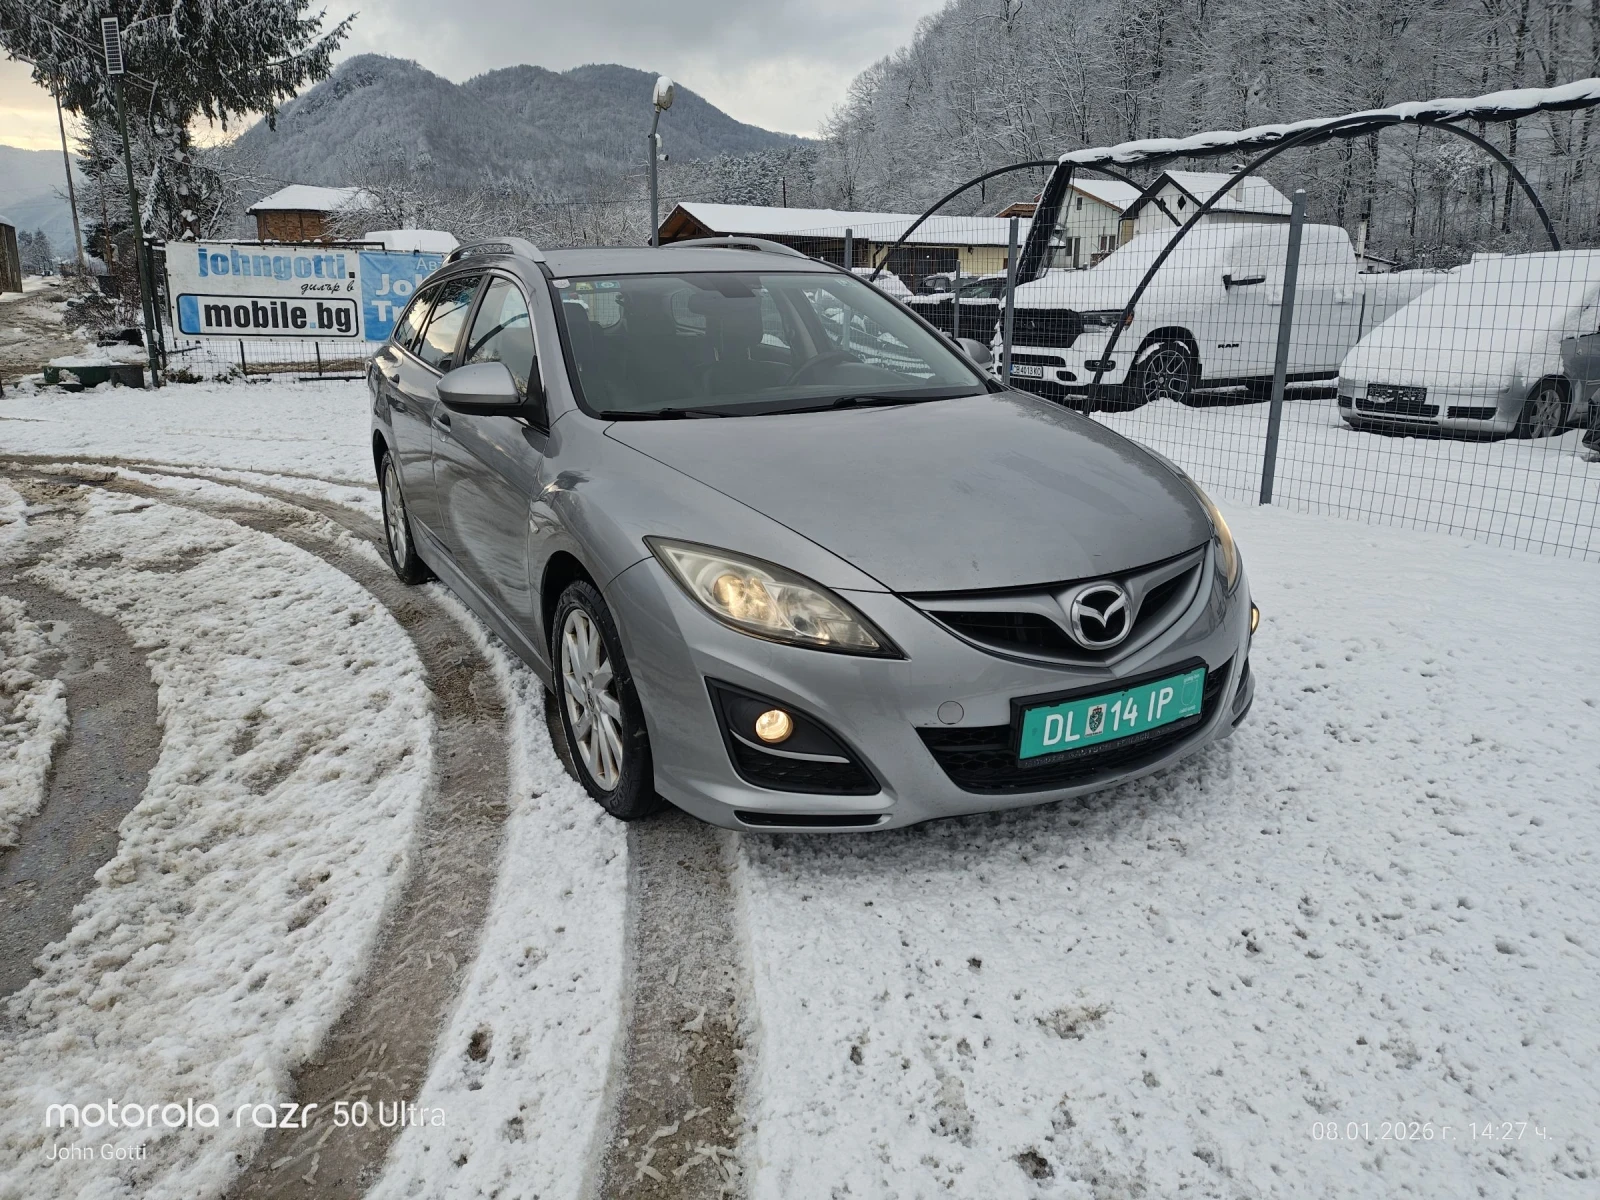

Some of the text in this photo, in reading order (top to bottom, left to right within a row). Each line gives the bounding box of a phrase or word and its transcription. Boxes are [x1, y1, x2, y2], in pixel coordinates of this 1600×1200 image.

[301, 283, 341, 295] дилър
[204, 300, 352, 333] mobile.bg
[1042, 710, 1080, 746] DL
[1111, 697, 1138, 731] 14
[1147, 687, 1174, 722] IP
